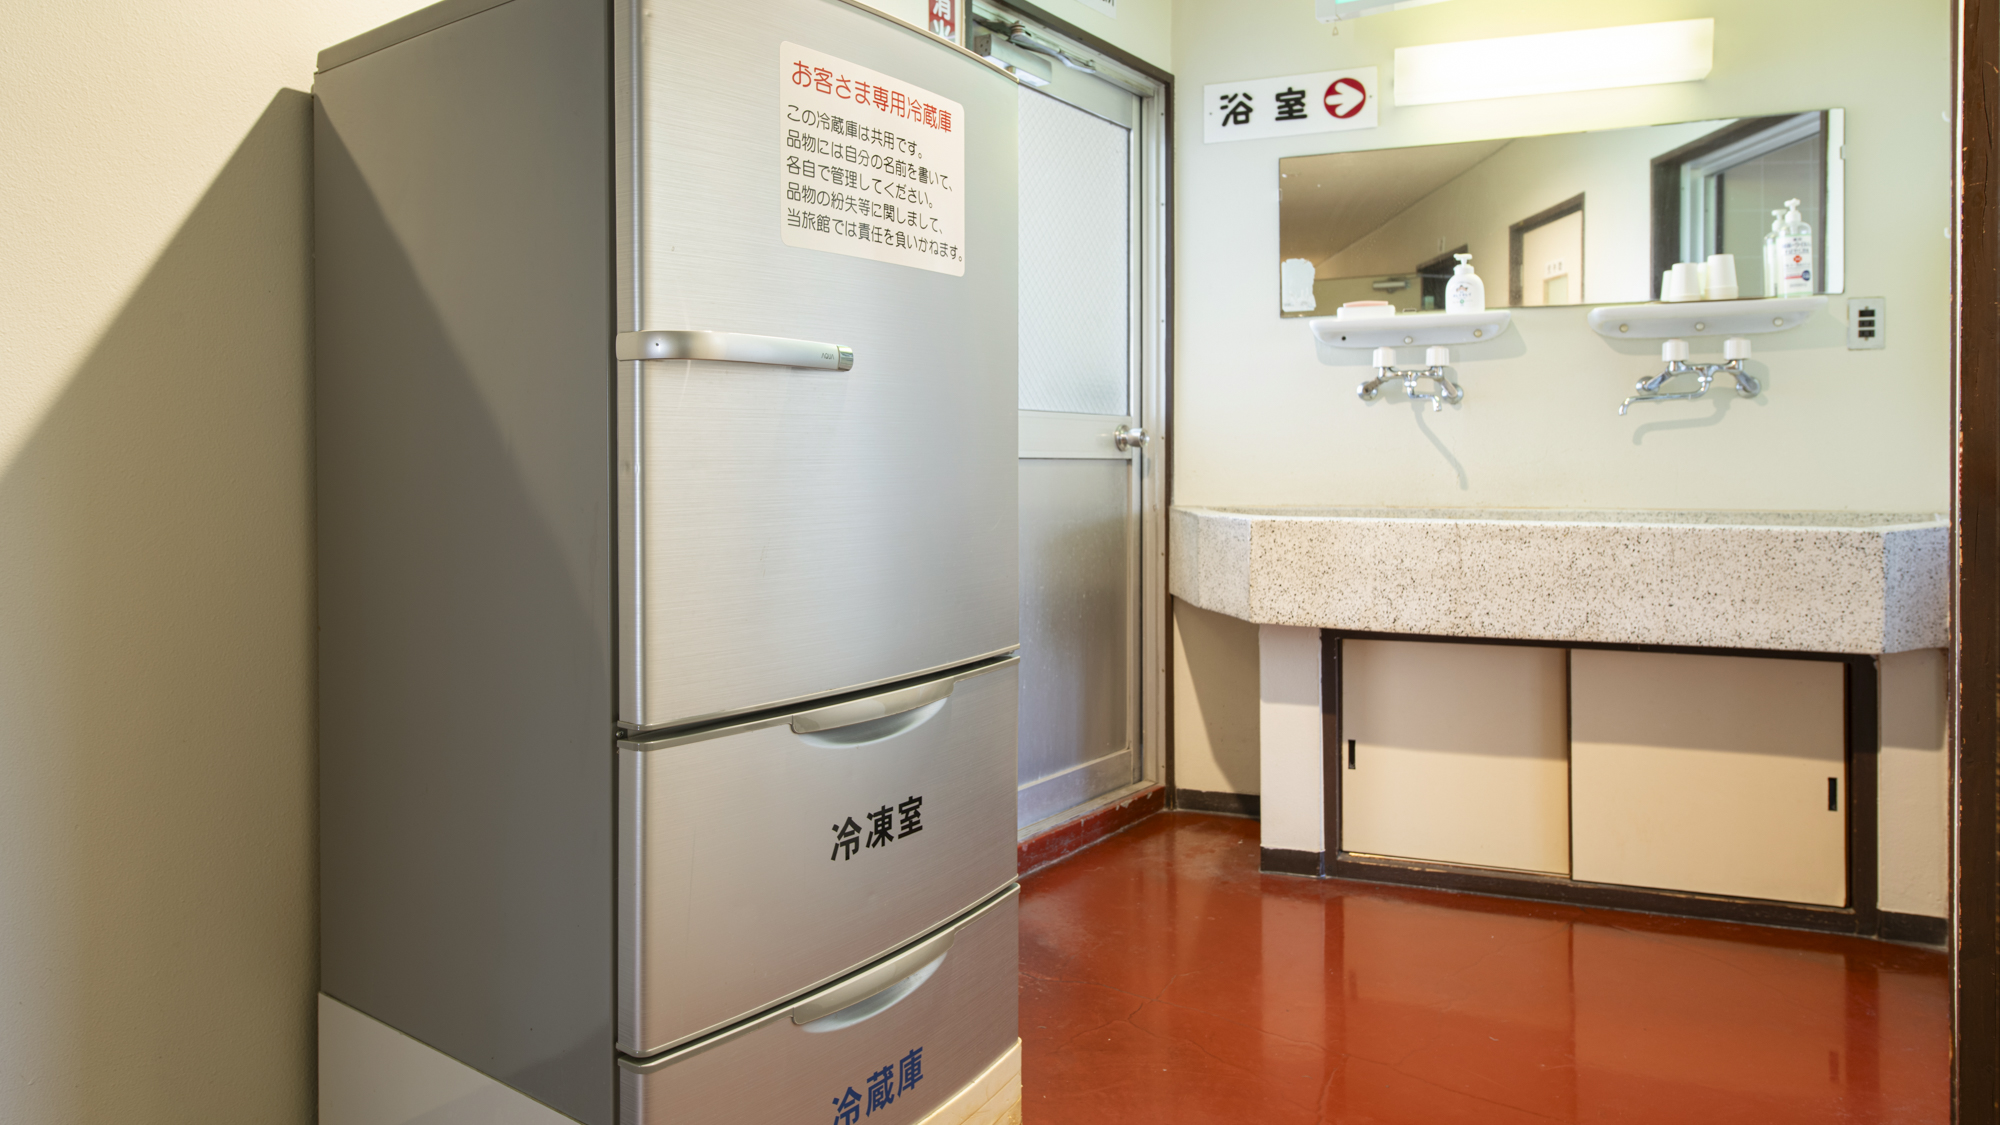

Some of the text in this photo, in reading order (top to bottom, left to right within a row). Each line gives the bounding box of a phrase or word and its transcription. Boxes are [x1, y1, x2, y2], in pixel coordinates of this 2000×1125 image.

[791, 60, 952, 133] お客さま専用冷蔵庫
[787, 104, 923, 159] この冷蔵庫は共用です。
[786, 129, 953, 192] 品物には自分の名前を書いて、
[786, 155, 933, 209] 各自で管理してください。
[786, 181, 943, 235] 品物の紛失等に関しまして、
[787, 207, 963, 262] 当旅館では責任を負いかねます。
[821, 352, 834, 360] AQUA
[830, 795, 923, 861] 冷凍室
[831, 1046, 924, 1125] 冷蔵庫
